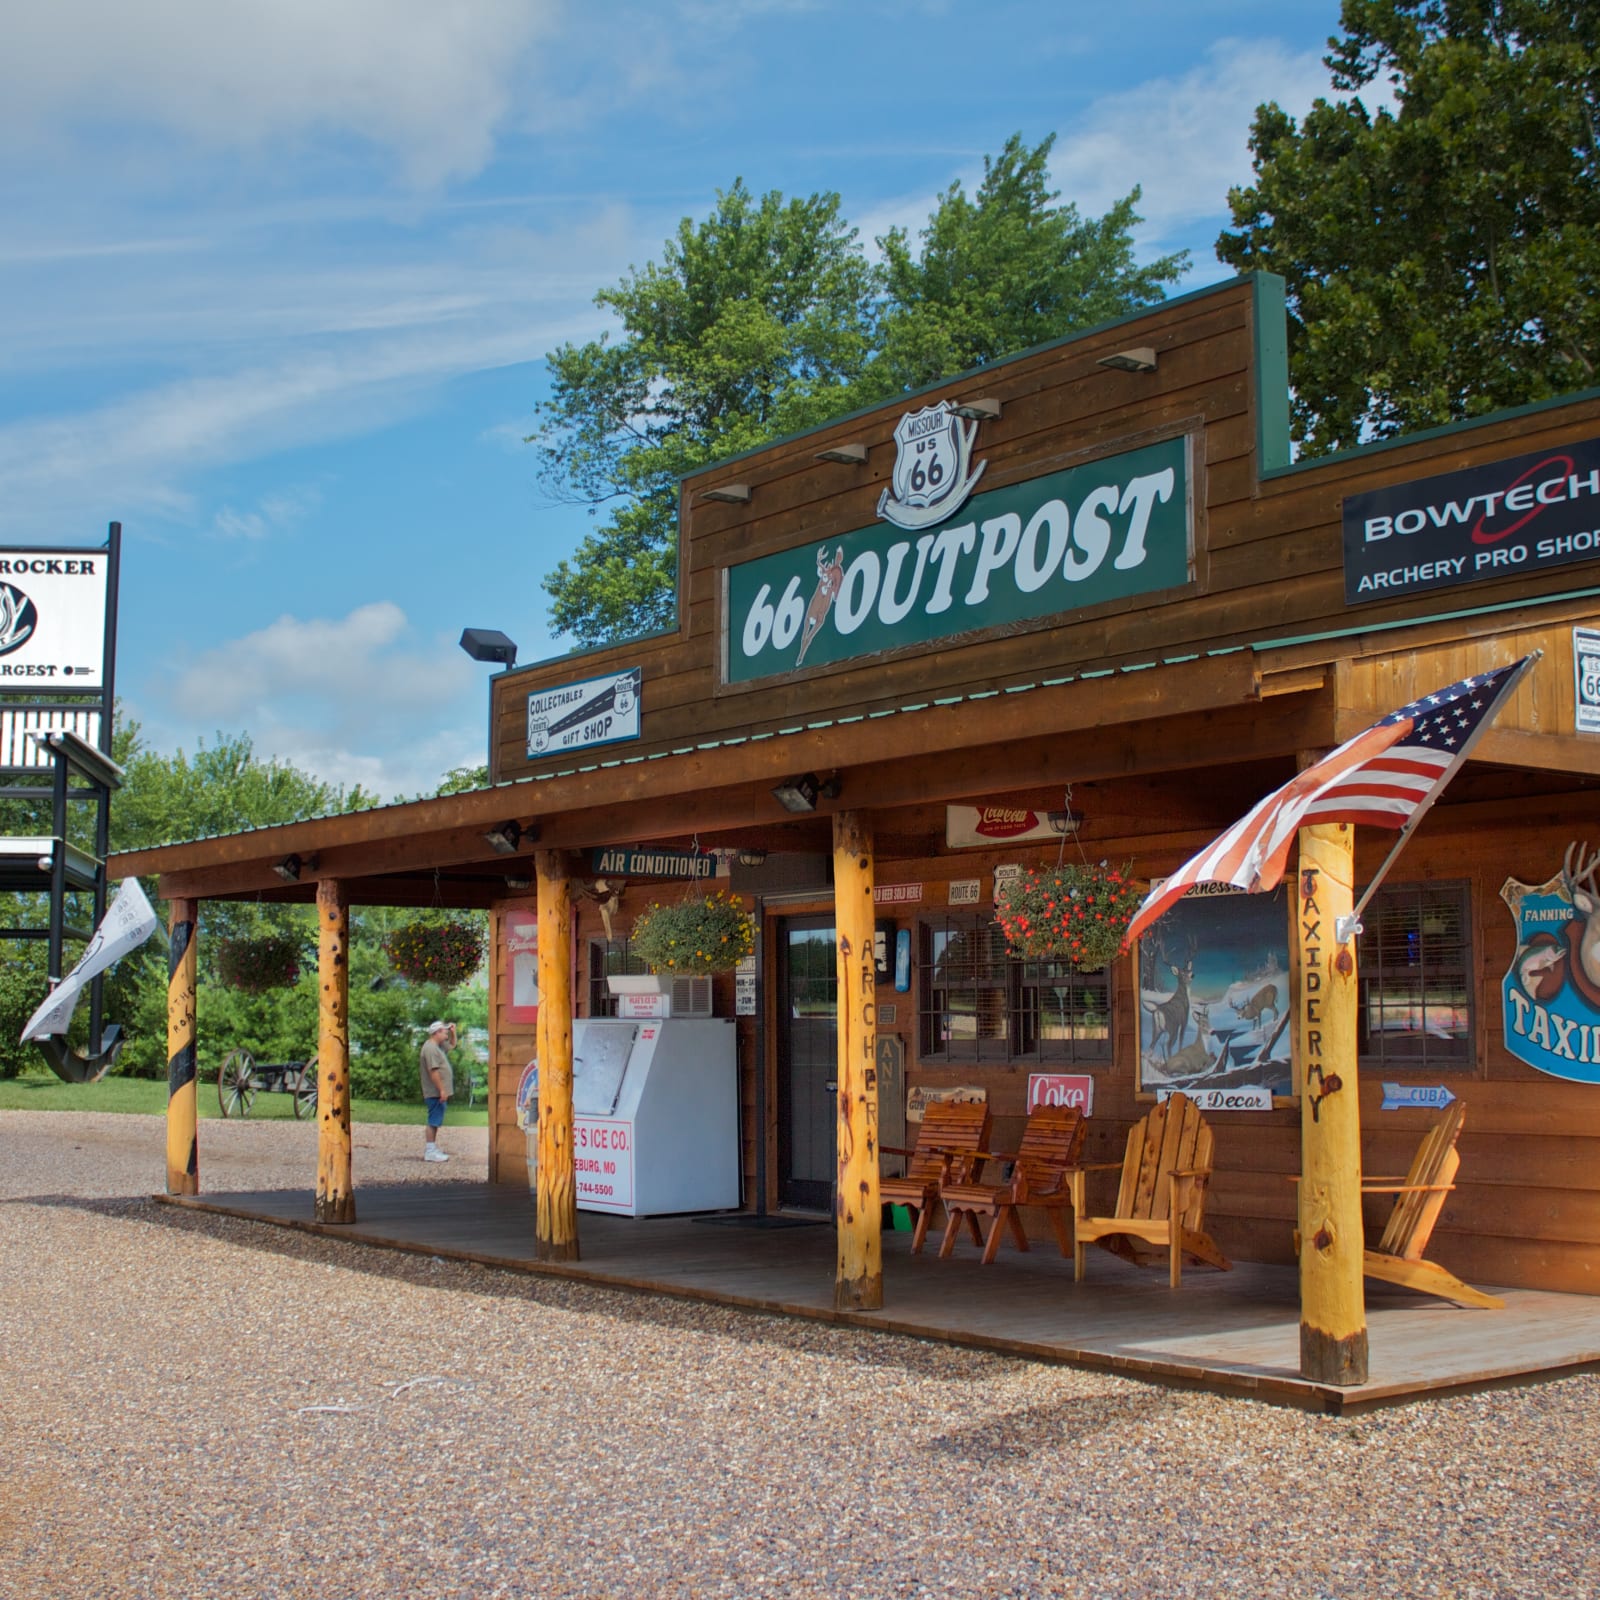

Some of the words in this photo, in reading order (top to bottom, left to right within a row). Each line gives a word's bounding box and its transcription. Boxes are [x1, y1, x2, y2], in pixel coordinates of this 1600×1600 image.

[908, 410, 943, 437] MISSOURI
[917, 438, 937, 454] US
[911, 452, 943, 491] 66
[1364, 469, 1600, 542] BOWTECH
[743, 576, 804, 656] 66
[835, 467, 1174, 634] OUTPOST
[1357, 556, 1466, 592] ARCHERY
[1475, 544, 1527, 570] PRO
[0, 664, 57, 676] RGEST
[530, 689, 583, 715] COLLECTABLES
[620, 698, 629, 709] 66
[563, 730, 580, 745] GIFT
[583, 716, 612, 740] SHOP
[630, 854, 710, 877] CONDITIONED
[951, 886, 969, 899] ROUTE
[970, 884, 979, 898] 66
[1524, 908, 1574, 922] FANNING
[1302, 869, 1325, 1124] TAXIDERMY
[861, 939, 877, 1163] ARCHERY
[1033, 1077, 1084, 1108] Coke
[1208, 1091, 1265, 1108] Decor
[1410, 1089, 1448, 1102] CUBA
[590, 1128, 608, 1149] ICE
[611, 1130, 630, 1151] CO.
[604, 1161, 616, 1175] MO
